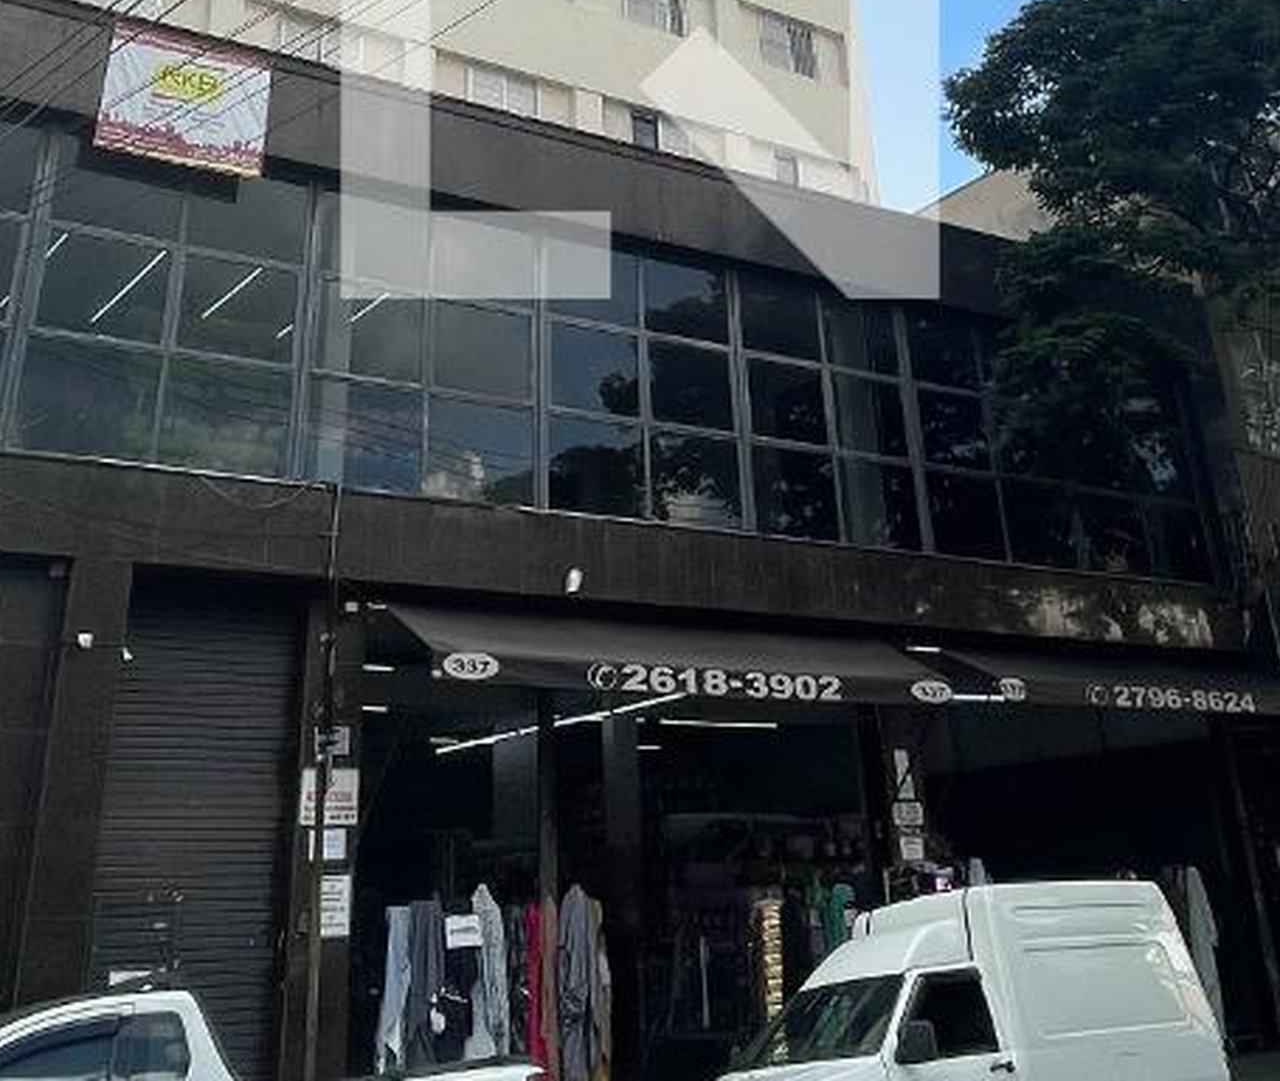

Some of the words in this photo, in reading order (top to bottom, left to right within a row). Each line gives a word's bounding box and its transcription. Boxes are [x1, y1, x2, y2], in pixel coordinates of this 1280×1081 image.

[452, 658, 490, 674] 337
[621, 663, 843, 701] 2618-3902
[1113, 685, 1257, 714] 2796-8624
